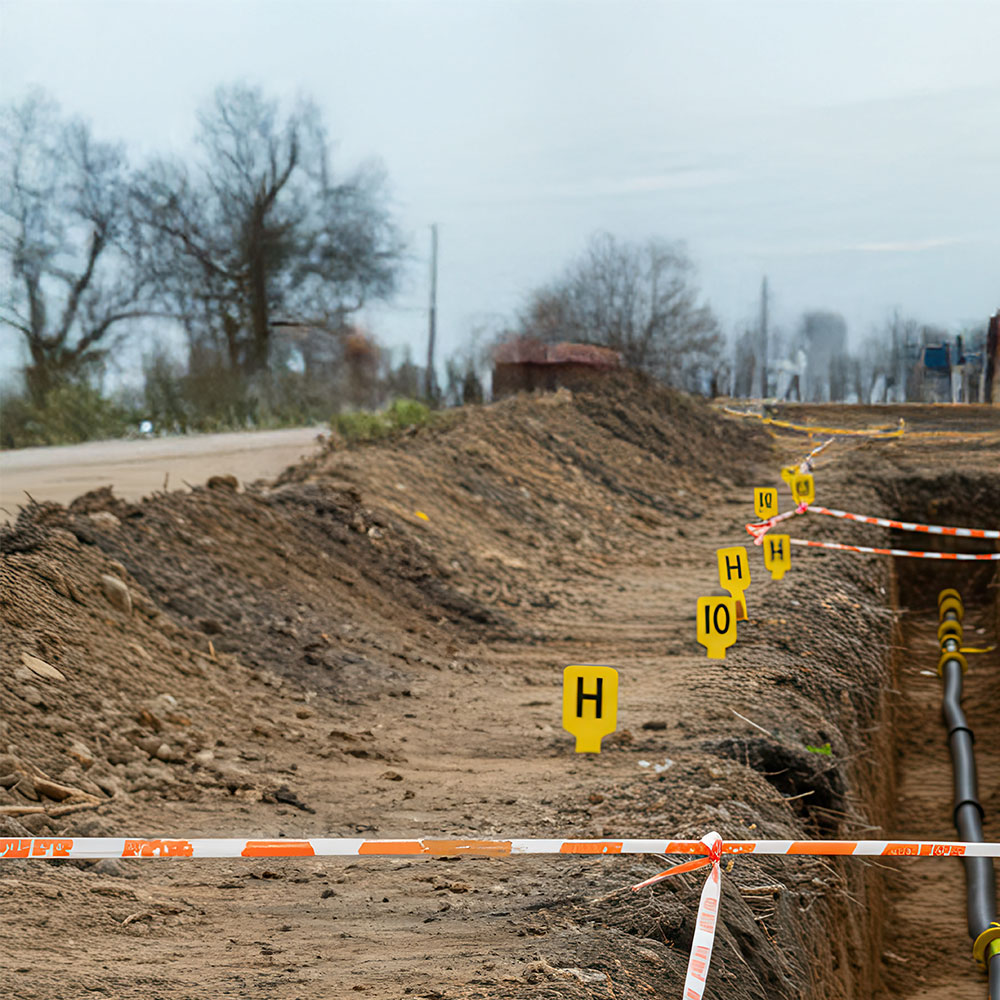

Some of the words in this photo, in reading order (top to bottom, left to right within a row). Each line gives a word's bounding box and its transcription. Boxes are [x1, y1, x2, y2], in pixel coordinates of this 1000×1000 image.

[771, 540, 783, 561] H
[726, 555, 742, 580] H
[705, 603, 730, 634] 10
[577, 677, 603, 719] H
